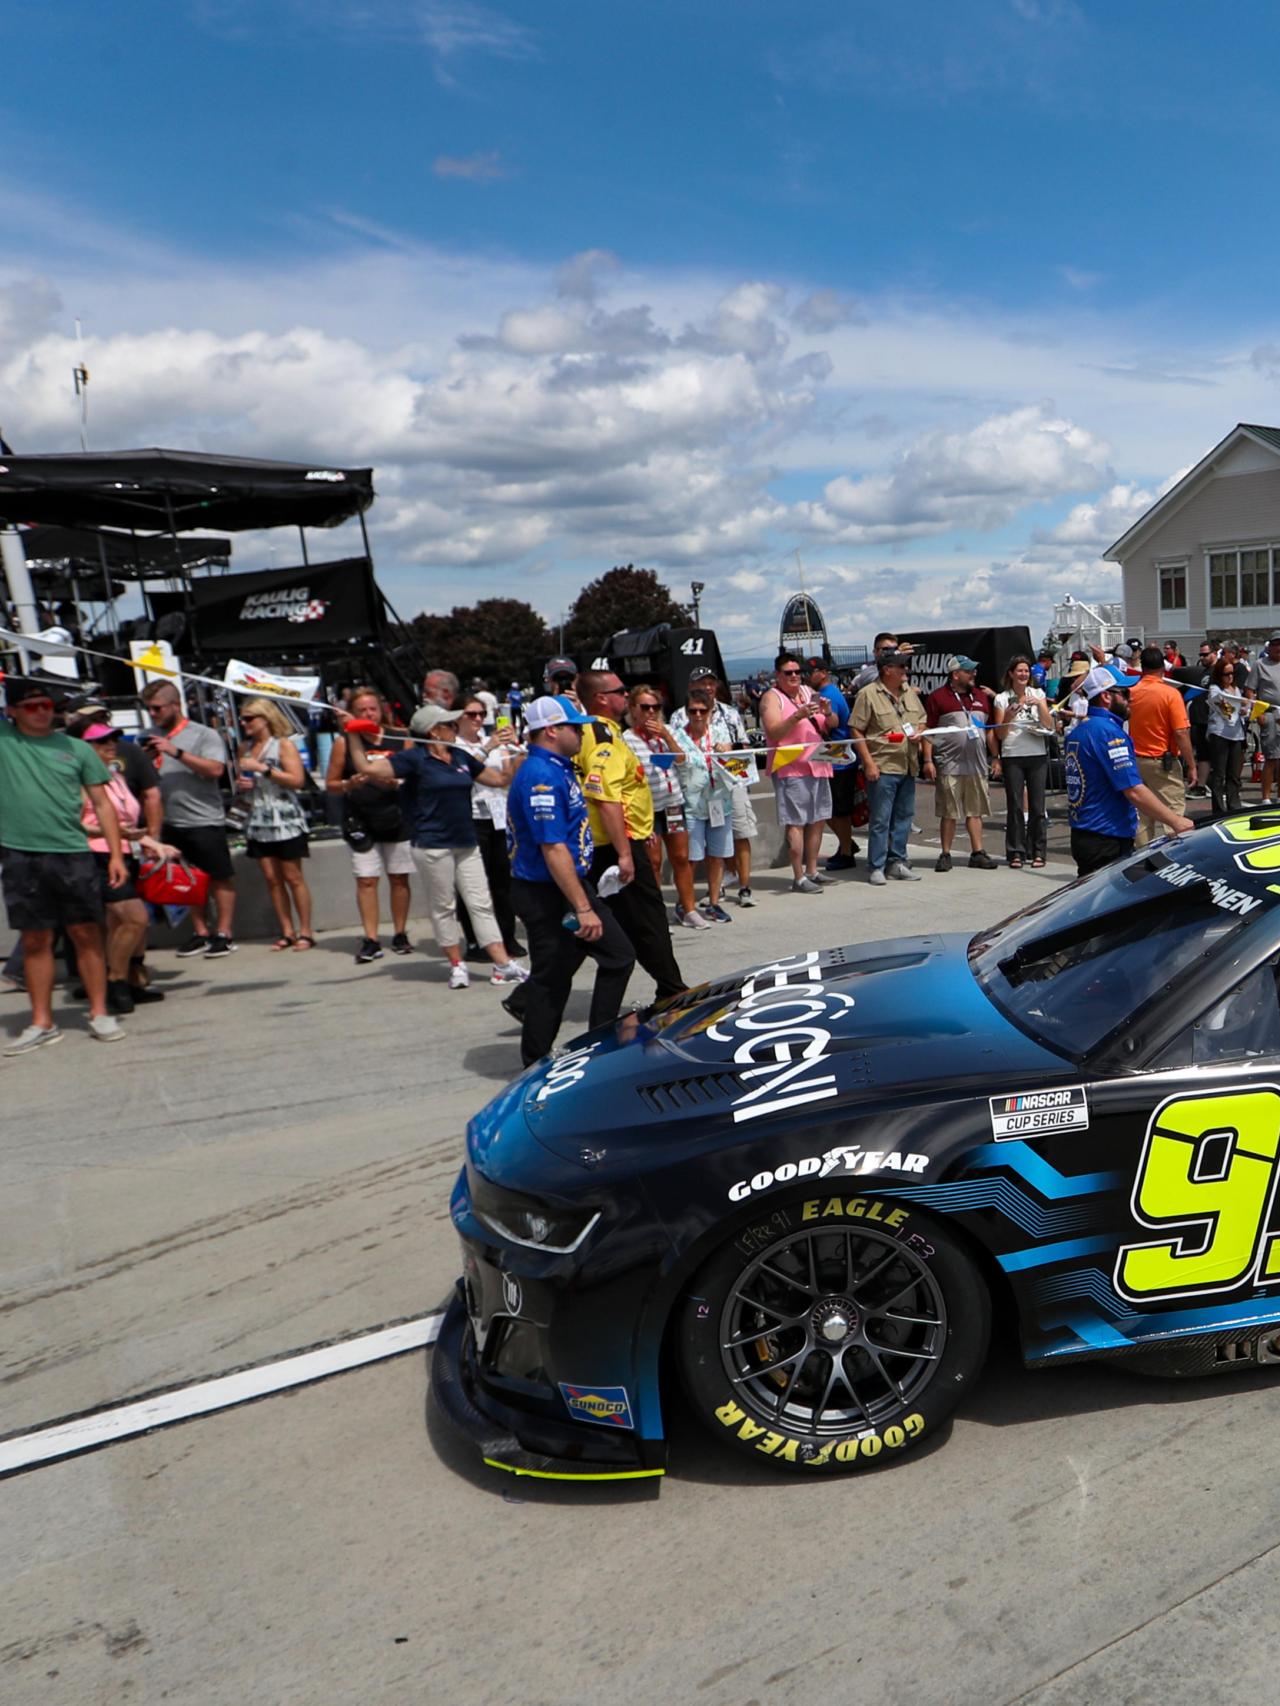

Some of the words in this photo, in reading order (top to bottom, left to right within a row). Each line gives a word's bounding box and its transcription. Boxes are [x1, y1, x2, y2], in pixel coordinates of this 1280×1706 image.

[244, 586, 310, 606] KAULIG
[239, 602, 309, 620] RACING
[680, 638, 704, 655] 41
[910, 674, 949, 694] RACIN
[1021, 1090, 1072, 1110] NASCAR
[1006, 1115, 1031, 1131] CUP
[1032, 1110, 1075, 1127] SERIES
[801, 1197, 911, 1229] EAGLE
[569, 1397, 624, 1412] SUNOCO
